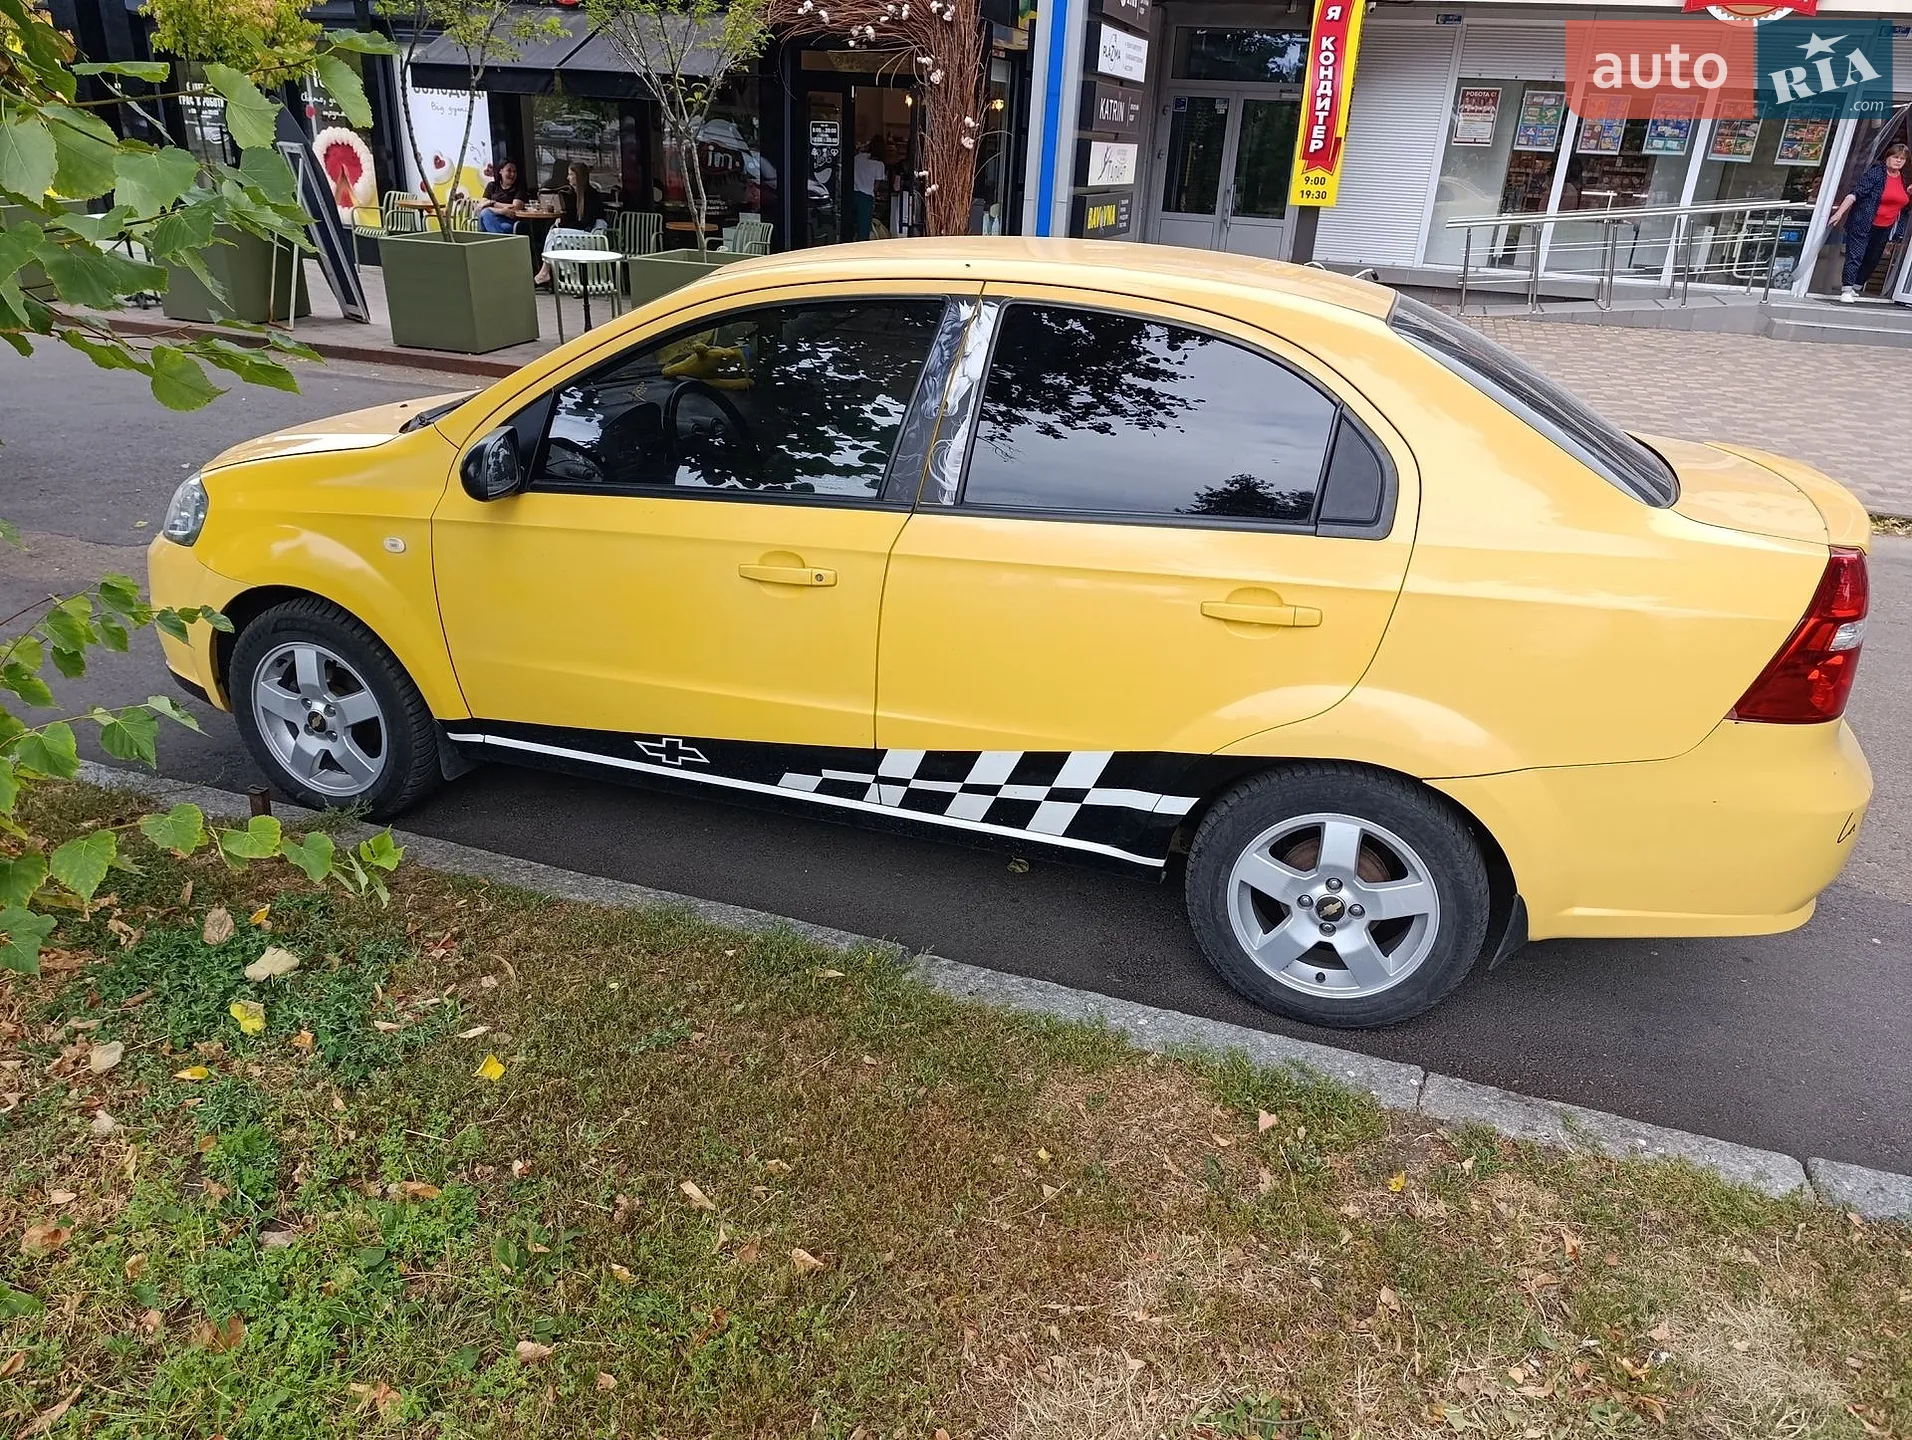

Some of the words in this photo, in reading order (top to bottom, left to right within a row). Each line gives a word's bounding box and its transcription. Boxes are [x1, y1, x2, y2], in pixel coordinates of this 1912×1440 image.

[1309, 36, 1336, 153] КОНДИТЕР
[1099, 97, 1126, 122] KATRIN
[1303, 176, 1327, 187] 9:00
[1299, 189, 1328, 201] 19:30
